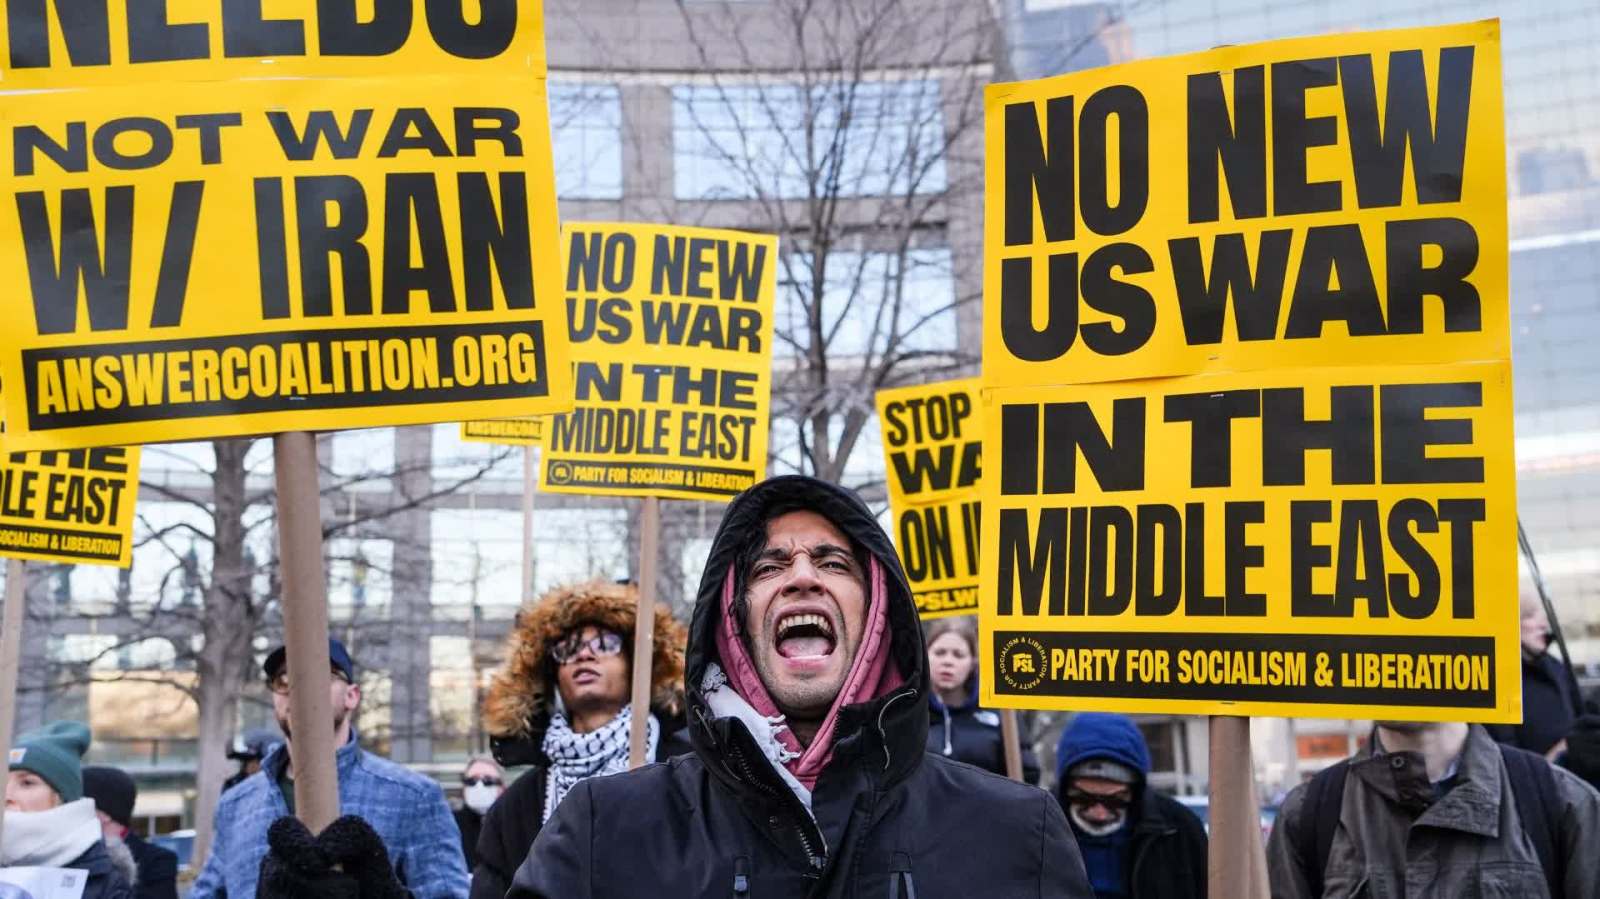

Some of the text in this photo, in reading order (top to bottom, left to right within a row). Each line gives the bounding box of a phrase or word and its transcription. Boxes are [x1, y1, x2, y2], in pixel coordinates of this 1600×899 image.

[13, 106, 524, 177] NOT WAR
[1004, 45, 1475, 247] NO NEW
[15, 171, 536, 336] W/ IRAN
[566, 232, 767, 303] NO NEW
[1001, 217, 1482, 362] US WAR
[565, 297, 763, 353] US WAR
[37, 333, 537, 415] ANSWERCOALITION.ORG
[572, 361, 759, 411] N THE
[550, 407, 756, 463] MIDDLE EAST
[885, 391, 971, 447] STOP
[1001, 381, 1485, 496] IN THE
[0, 469, 126, 526] LE EAST
[574, 466, 754, 490] PARTY FOR SOCIALISM & LIBERATION
[50, 533, 58, 550] &
[61, 535, 120, 555] LIBERATION
[900, 505, 956, 583] ON
[997, 498, 1486, 620] MIDDLE EAST
[1012, 653, 1036, 673] PSL
[1051, 648, 1489, 690] PARTY FOR SOCIALISM & LIBERATION
